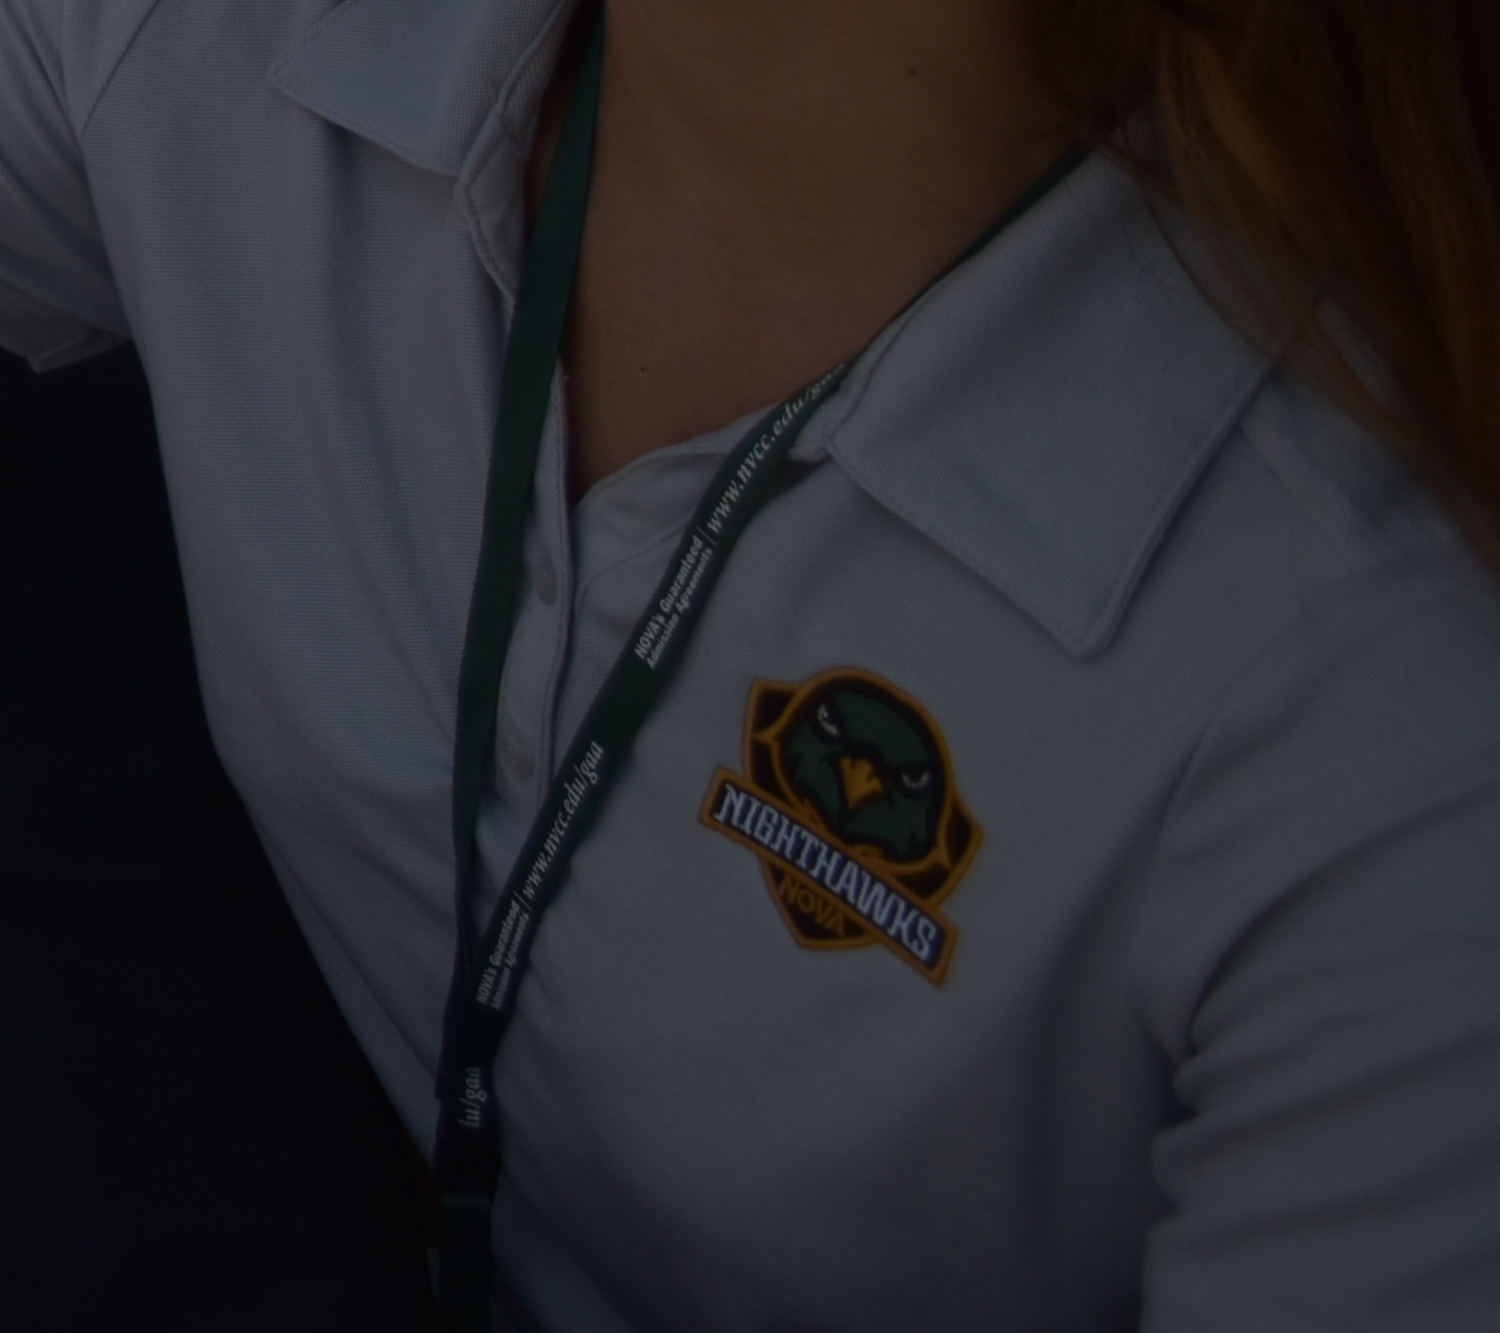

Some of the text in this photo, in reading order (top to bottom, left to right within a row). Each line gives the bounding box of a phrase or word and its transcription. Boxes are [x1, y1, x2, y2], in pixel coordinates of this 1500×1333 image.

[634, 534, 704, 661] NOVA's Guaranteed
[645, 546, 713, 671] Admission Agreements
[522, 739, 605, 901] www.nvcc.edu/gaa
[712, 781, 939, 963] NIGHTHAWKS
[475, 899, 521, 1006] NOVA's Guaranteed
[778, 872, 847, 937] NOVA
